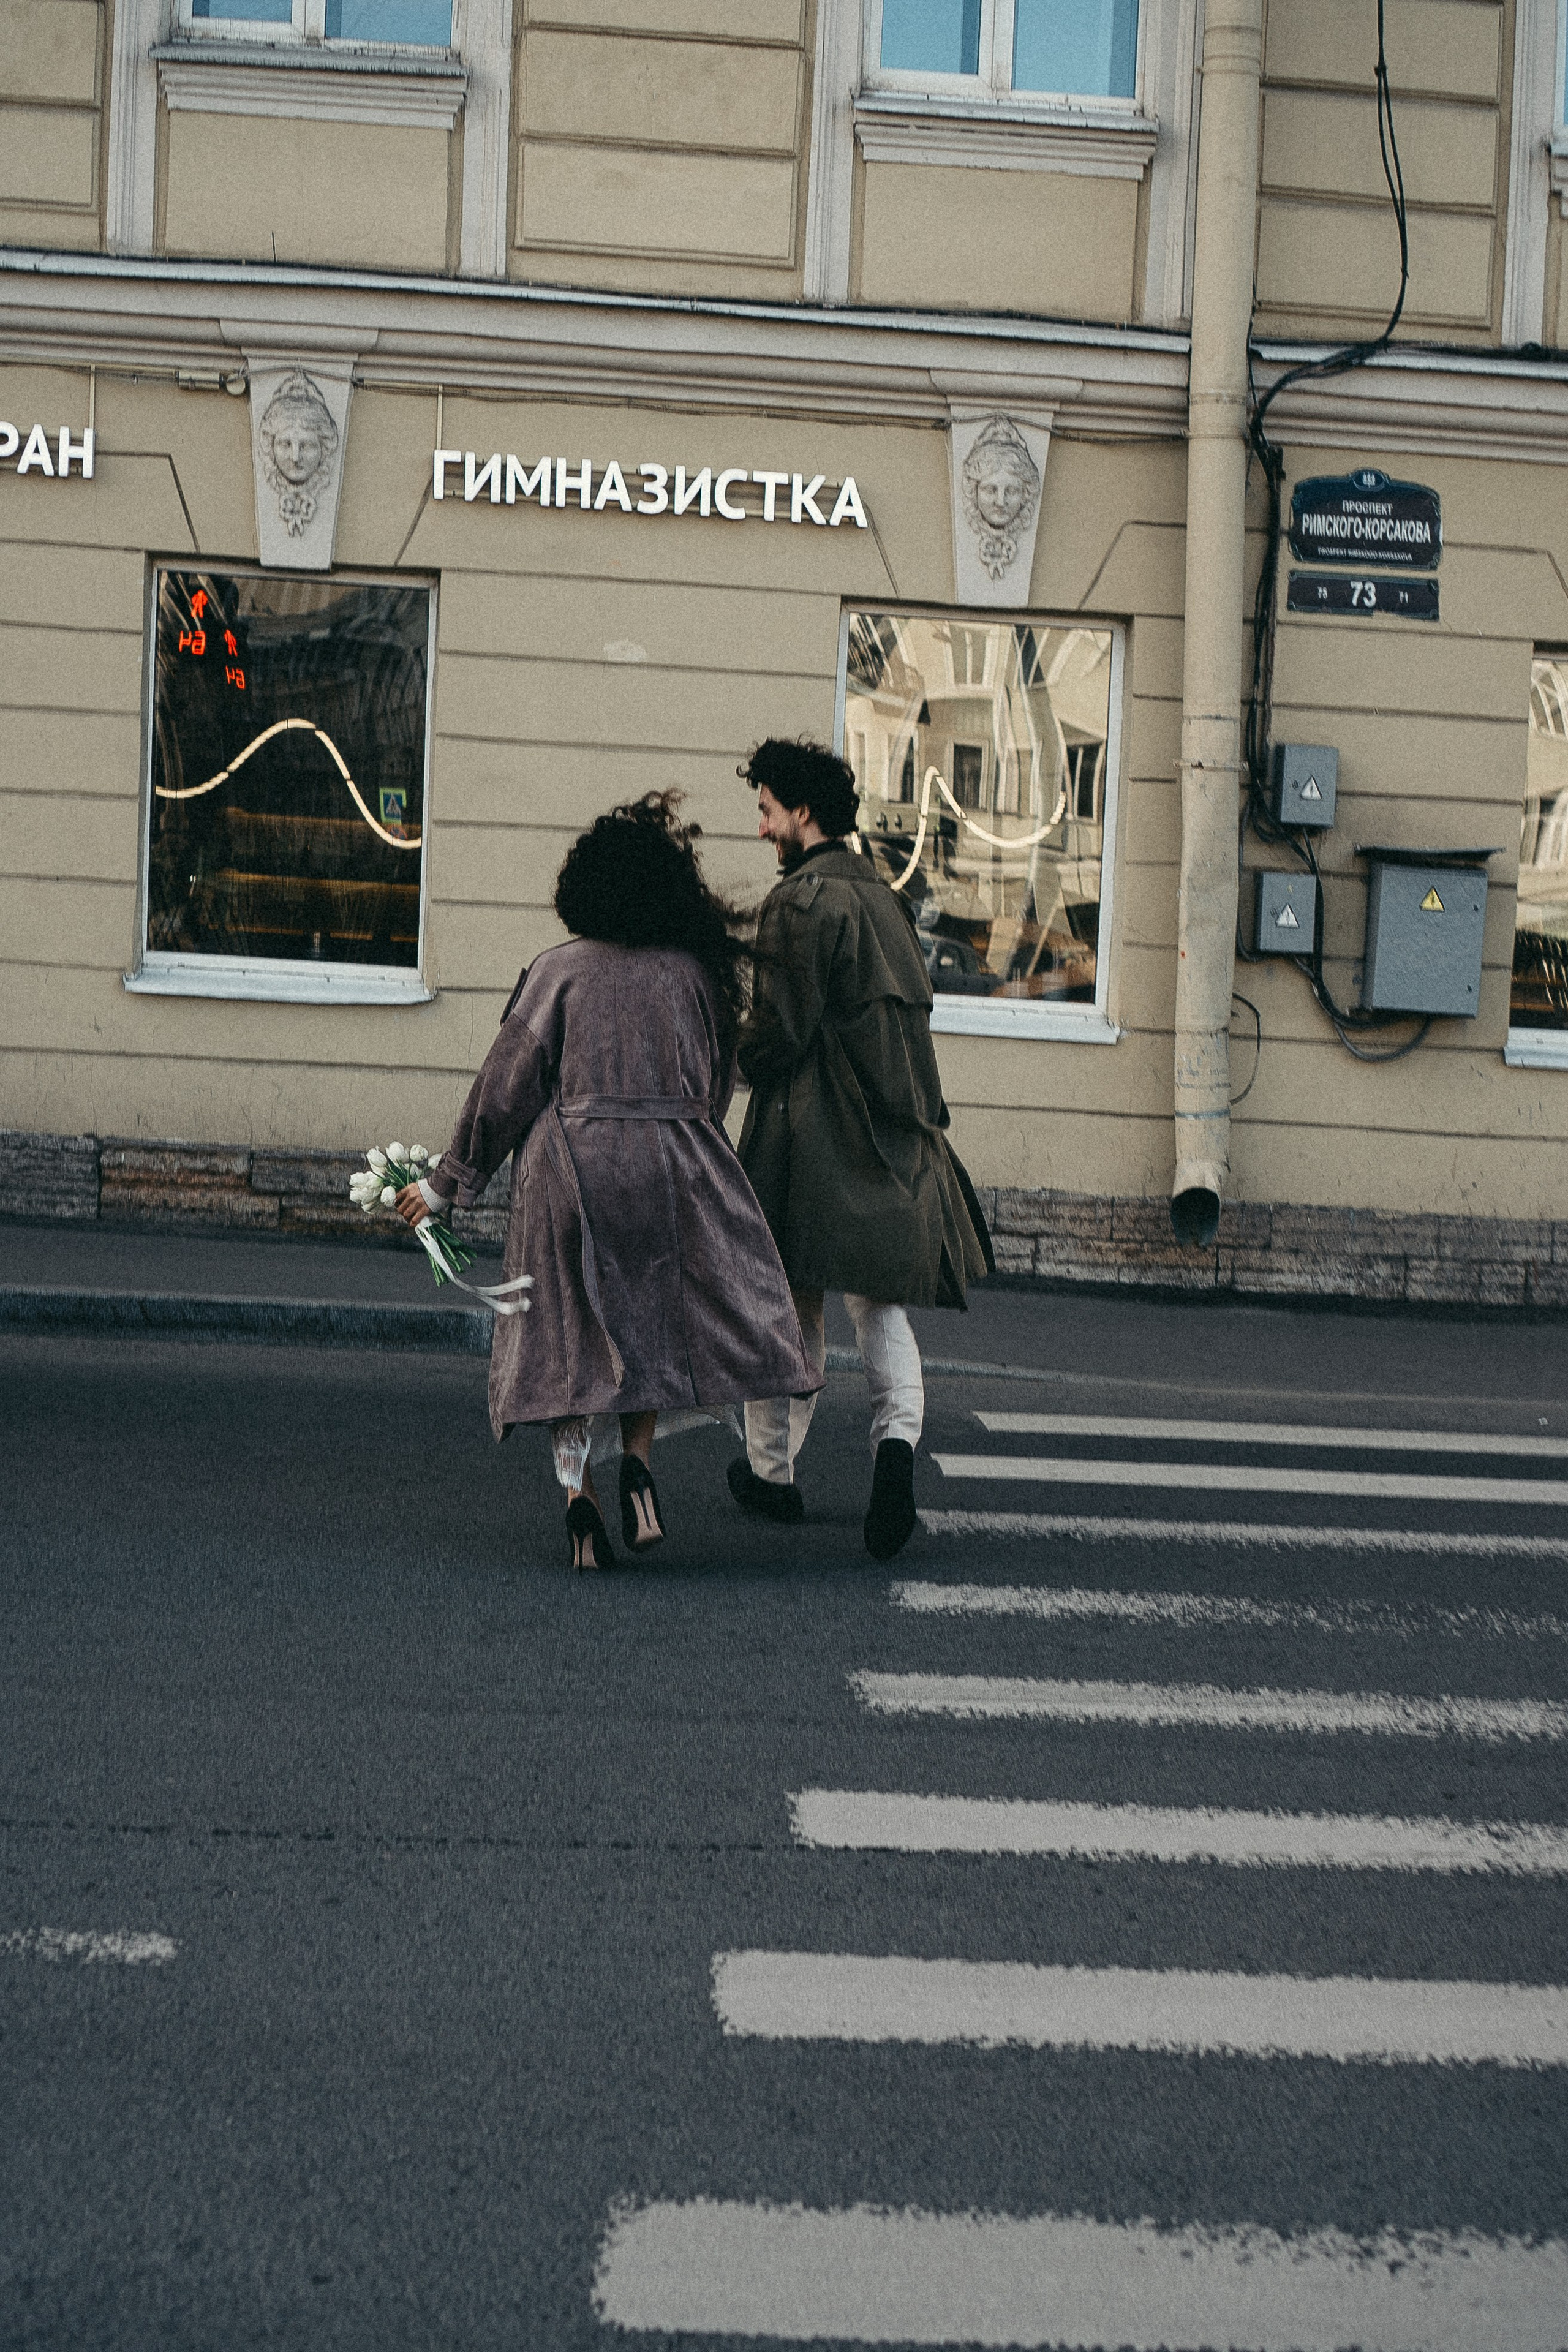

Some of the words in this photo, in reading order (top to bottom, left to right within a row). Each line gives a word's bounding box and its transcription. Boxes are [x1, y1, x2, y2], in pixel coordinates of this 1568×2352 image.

[433, 449, 869, 528] ГИМНАЗИСТКА
[1342, 500, 1393, 516] ПРОСПЕКТ
[1302, 513, 1431, 544] РИМСКОГО-КОРСАКОВА
[1350, 581, 1376, 608] 73
